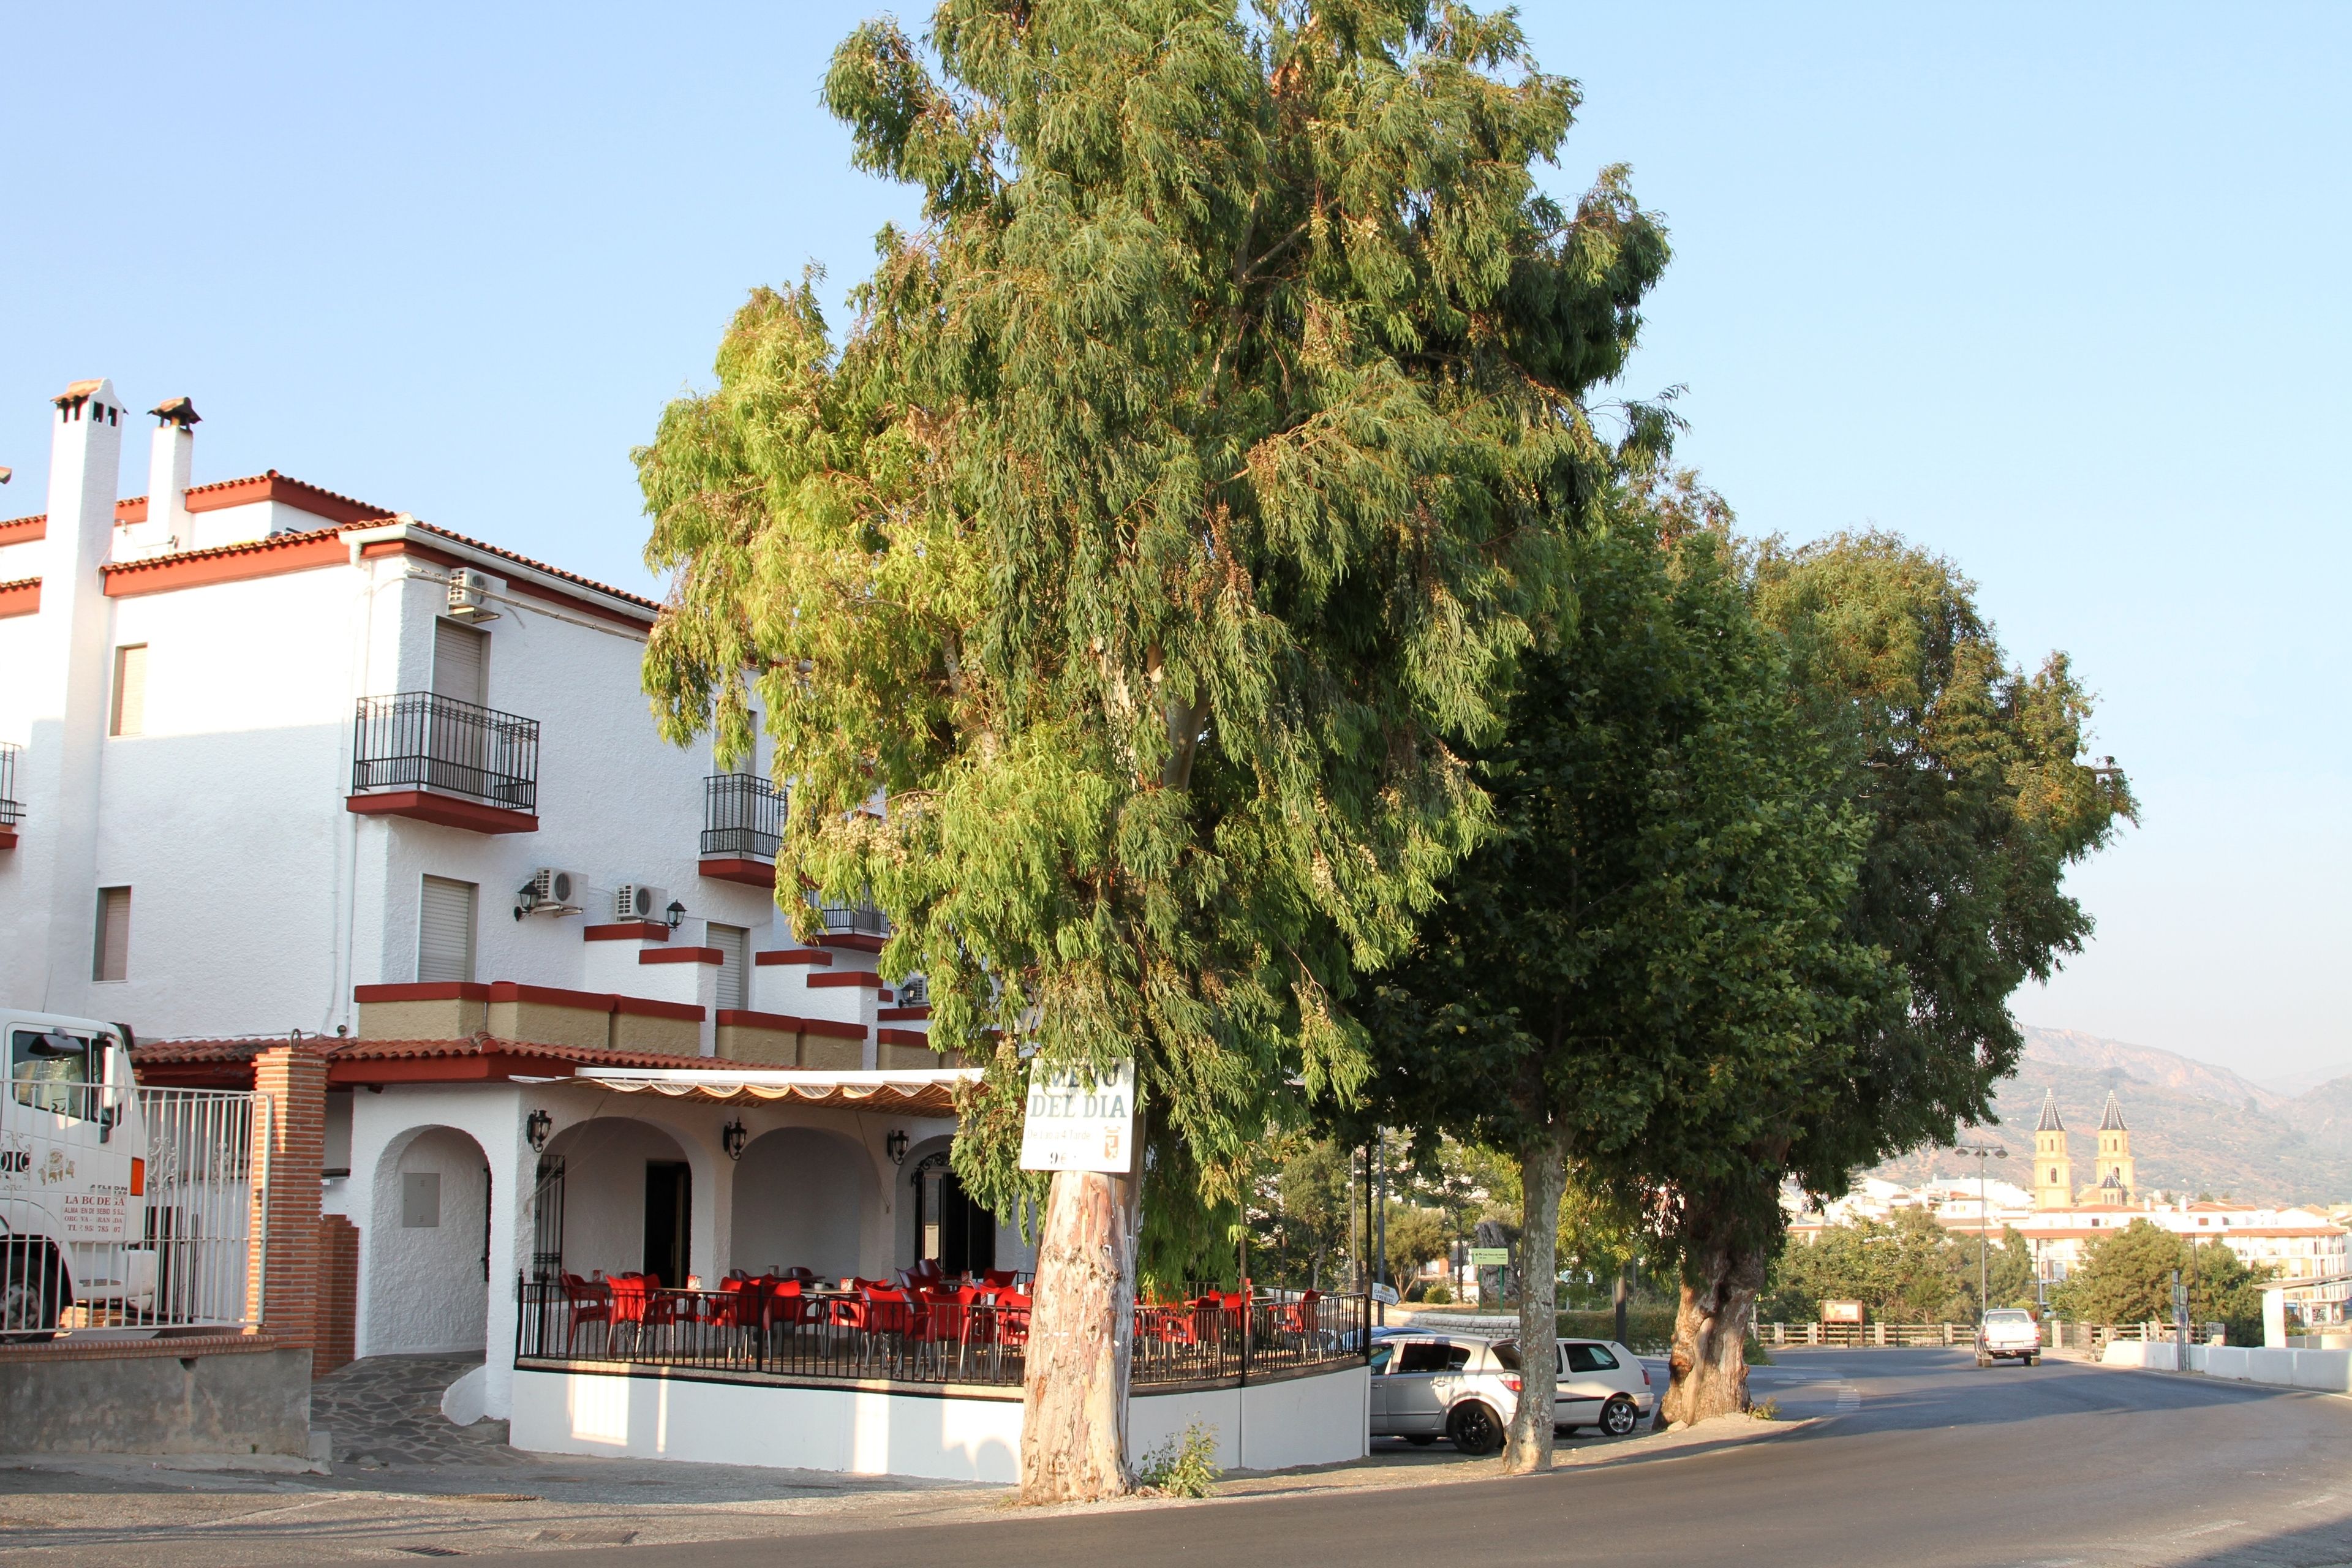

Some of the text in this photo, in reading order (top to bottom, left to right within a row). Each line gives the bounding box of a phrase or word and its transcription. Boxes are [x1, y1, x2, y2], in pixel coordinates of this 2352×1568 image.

[1030, 1095, 1127, 1118] DEL DIA
[66, 1196, 78, 1204] LA
